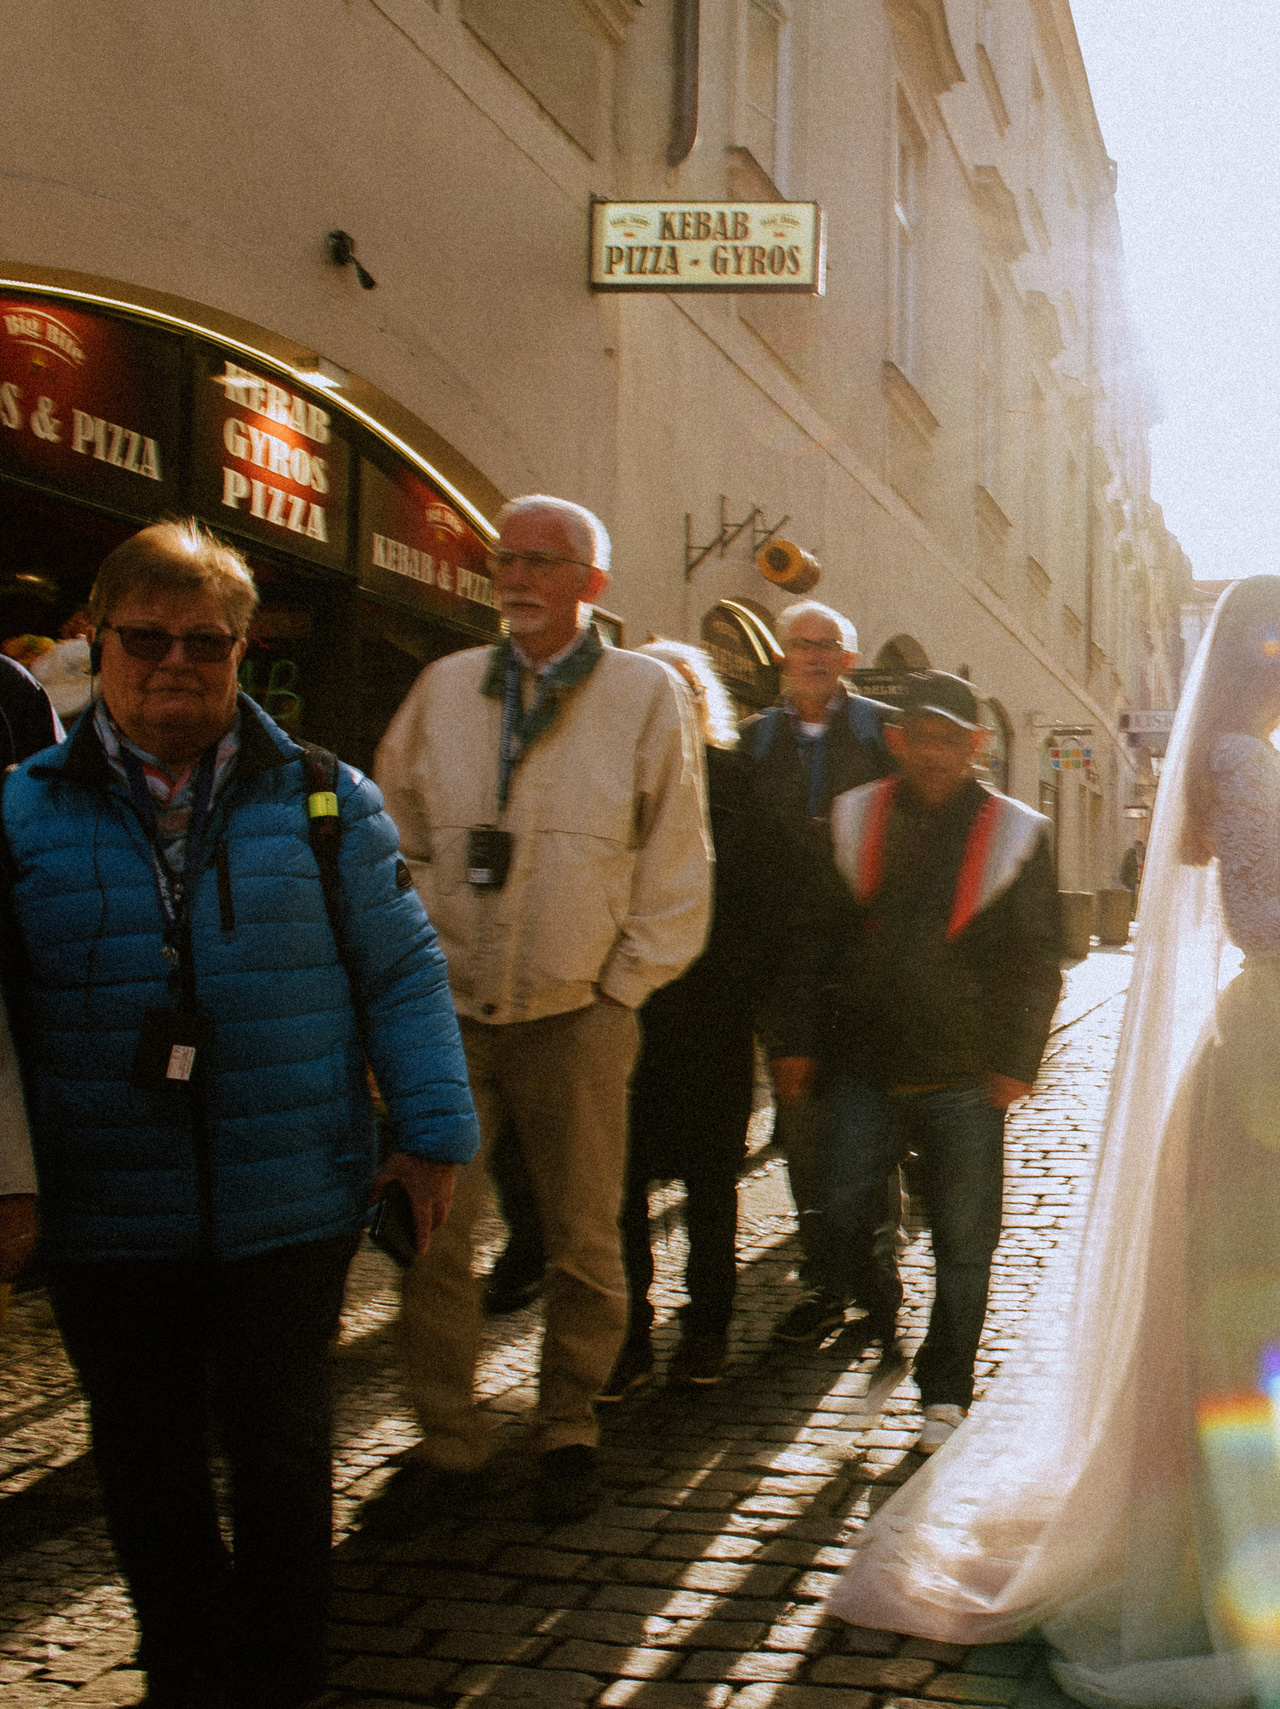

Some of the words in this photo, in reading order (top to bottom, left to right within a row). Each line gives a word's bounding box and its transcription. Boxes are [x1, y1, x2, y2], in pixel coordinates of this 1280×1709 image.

[604, 245, 681, 276] PIZZA
[710, 245, 802, 276] GYROS
[658, 211, 750, 241] KEBAB
[29, 394, 65, 444] &
[70, 406, 164, 482] PIZZA
[223, 359, 333, 445] KEBAB
[222, 416, 331, 495] GYROS
[220, 465, 330, 543] PIZZA
[371, 531, 434, 585] KEBAB
[436, 559, 455, 592] &
